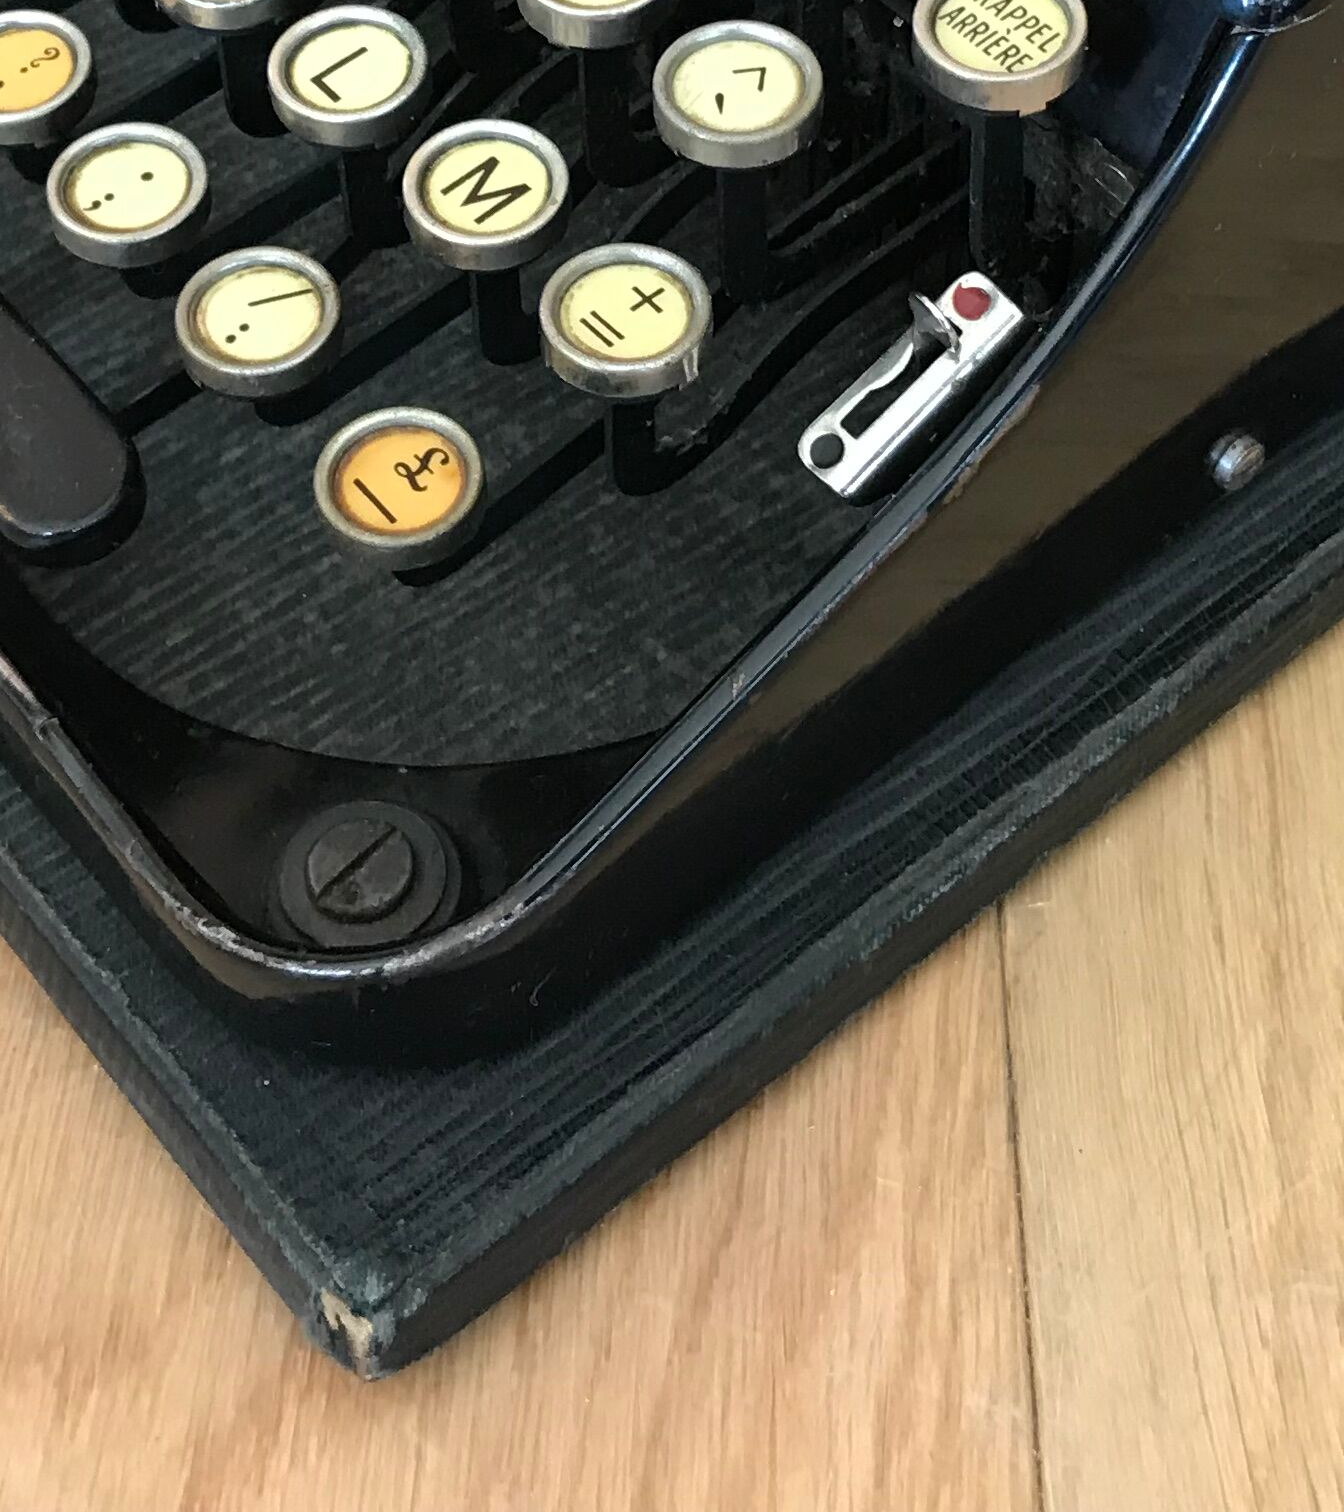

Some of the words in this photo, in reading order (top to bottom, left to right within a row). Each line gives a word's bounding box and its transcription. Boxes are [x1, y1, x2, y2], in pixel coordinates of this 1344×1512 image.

[937, 6, 1034, 74] ARRIÈRE
[309, 46, 370, 104] L
[438, 155, 533, 226] M
